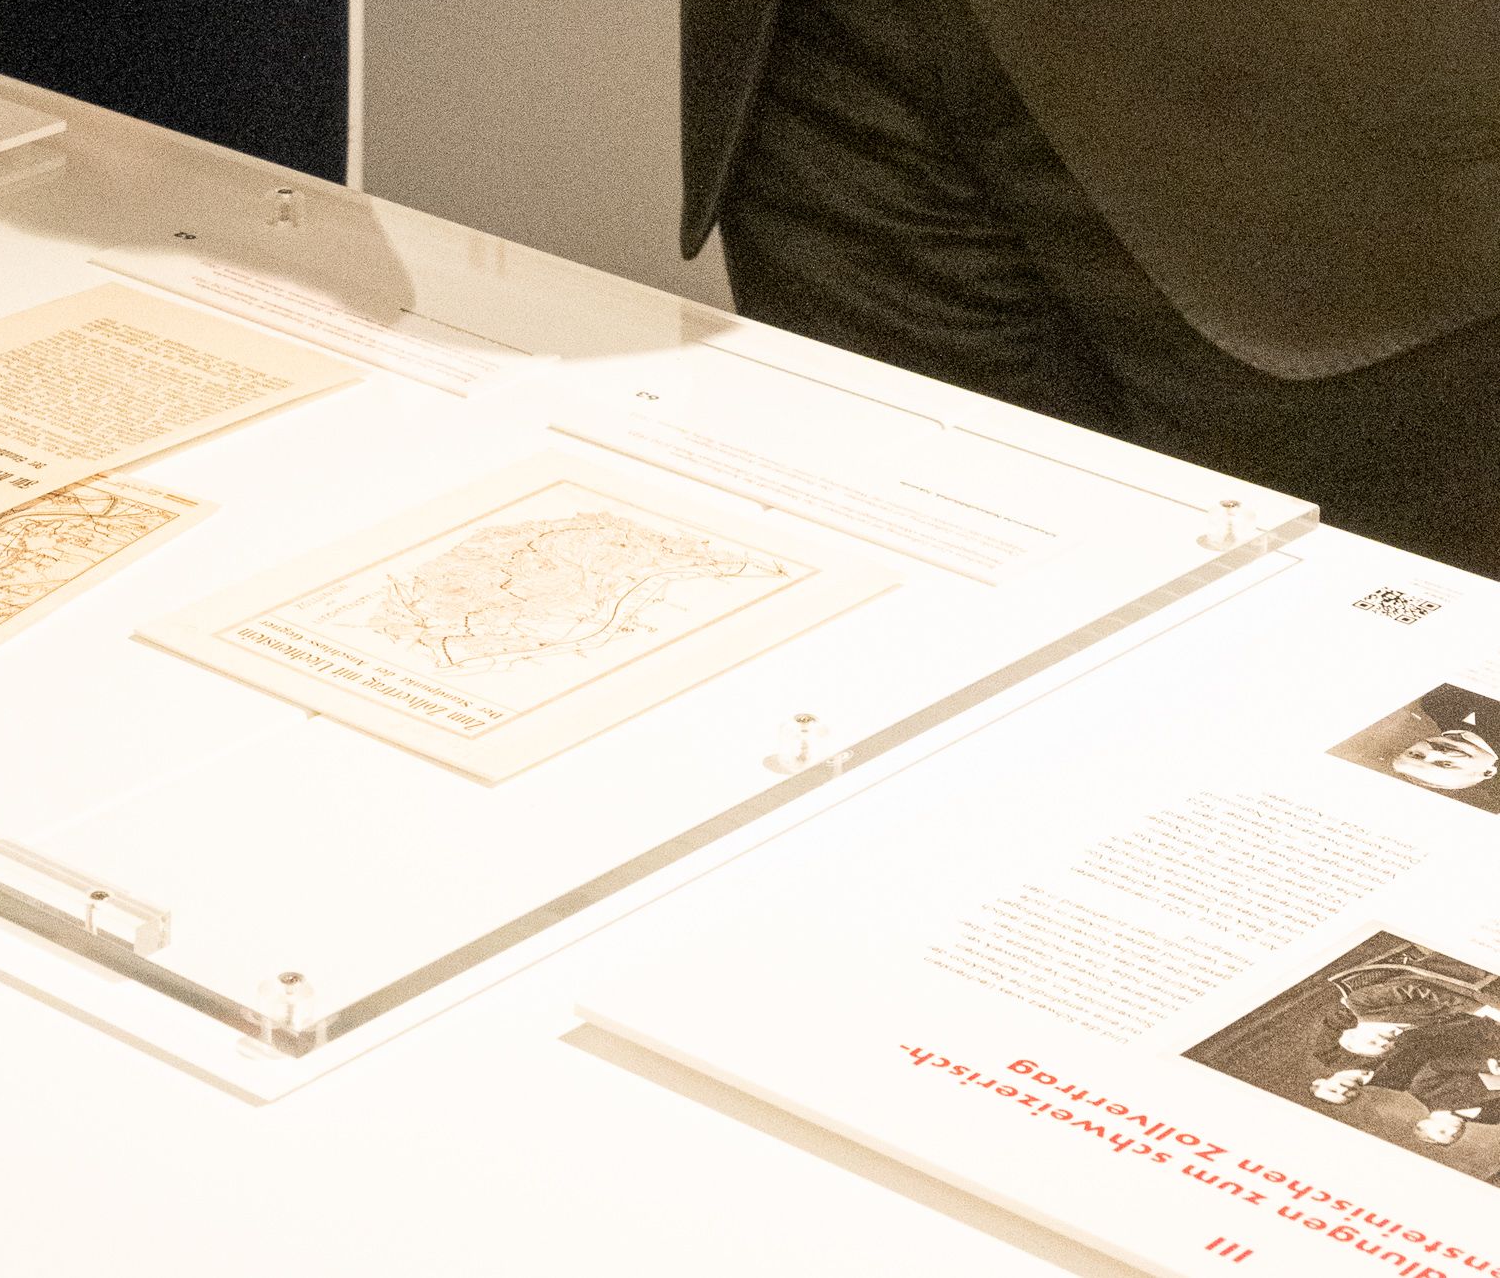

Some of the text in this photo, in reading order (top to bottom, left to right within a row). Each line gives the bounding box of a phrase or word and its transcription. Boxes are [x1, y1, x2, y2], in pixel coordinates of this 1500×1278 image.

[235, 627, 487, 731] Zum Zollvertrag mit Liechtenstein
[257, 619, 504, 719] Der Standpunkt der Anschluss-Gegner
[896, 1043, 1173, 1164] schweizerisch-
[1005, 1054, 1232, 1162] Zollvertrag
[1176, 1164, 1268, 1205] zum
[1200, 1235, 1258, 1263] III
